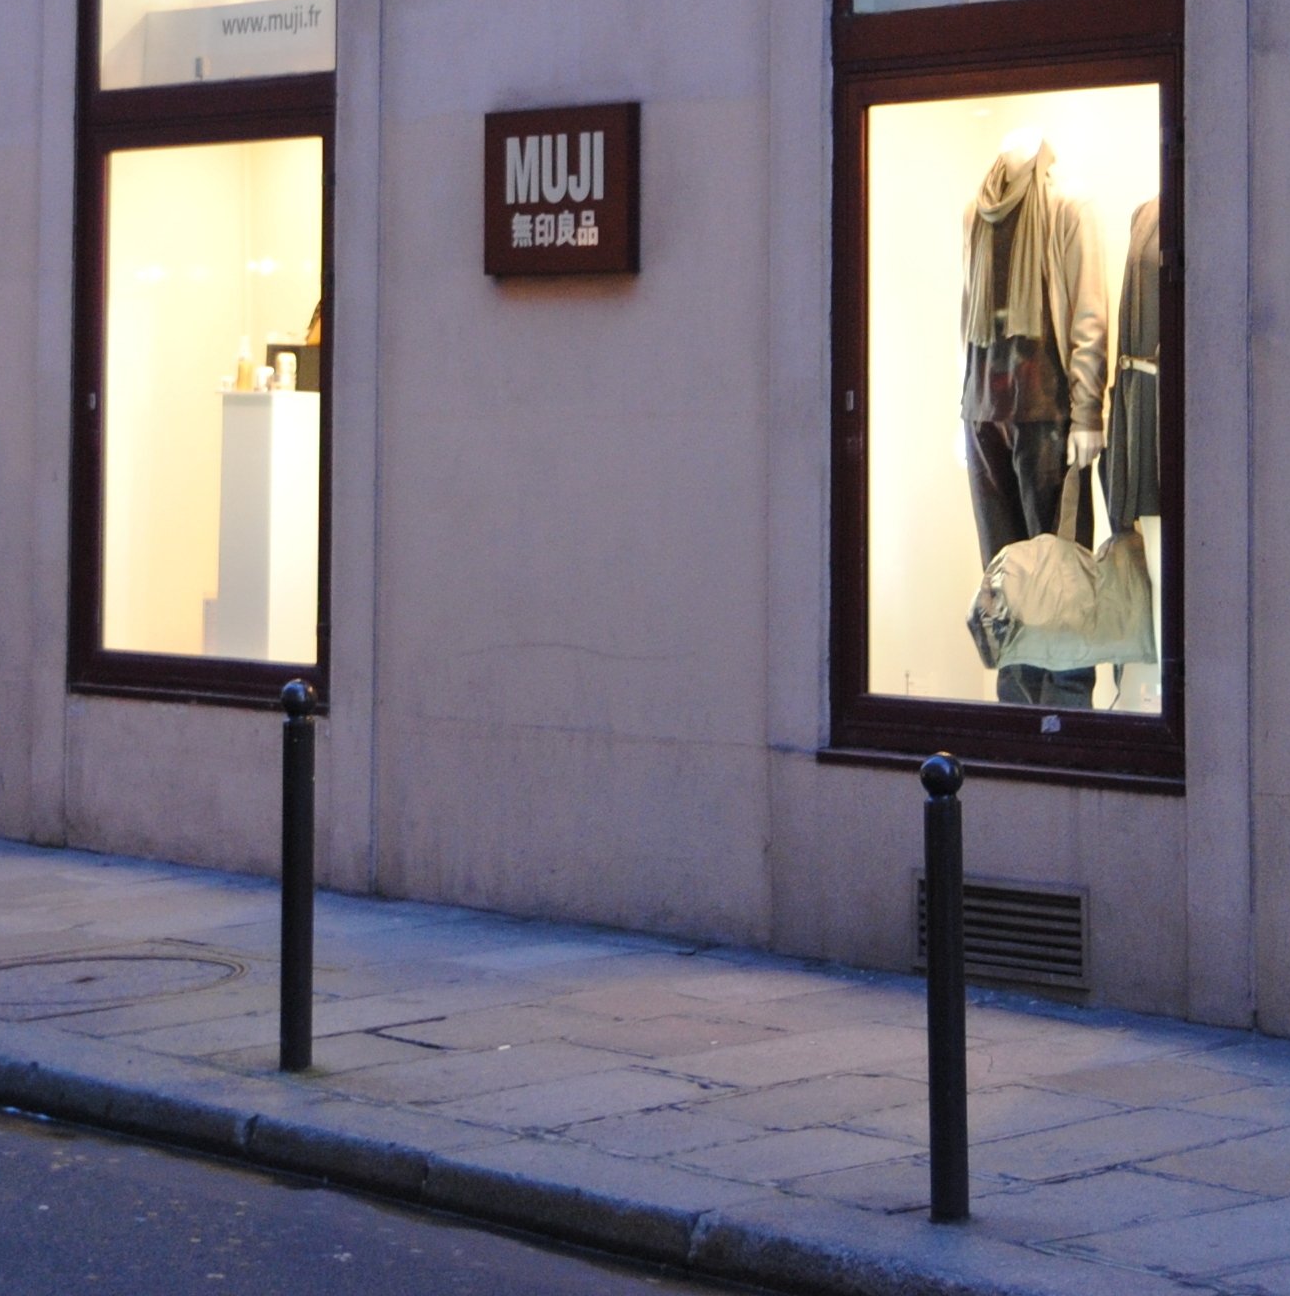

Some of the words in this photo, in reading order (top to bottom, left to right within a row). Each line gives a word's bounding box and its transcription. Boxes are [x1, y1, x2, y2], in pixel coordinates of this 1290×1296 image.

[221, 5, 321, 36] www.muji.fr
[506, 131, 605, 204] MUJI
[512, 210, 599, 248] 無印良品
